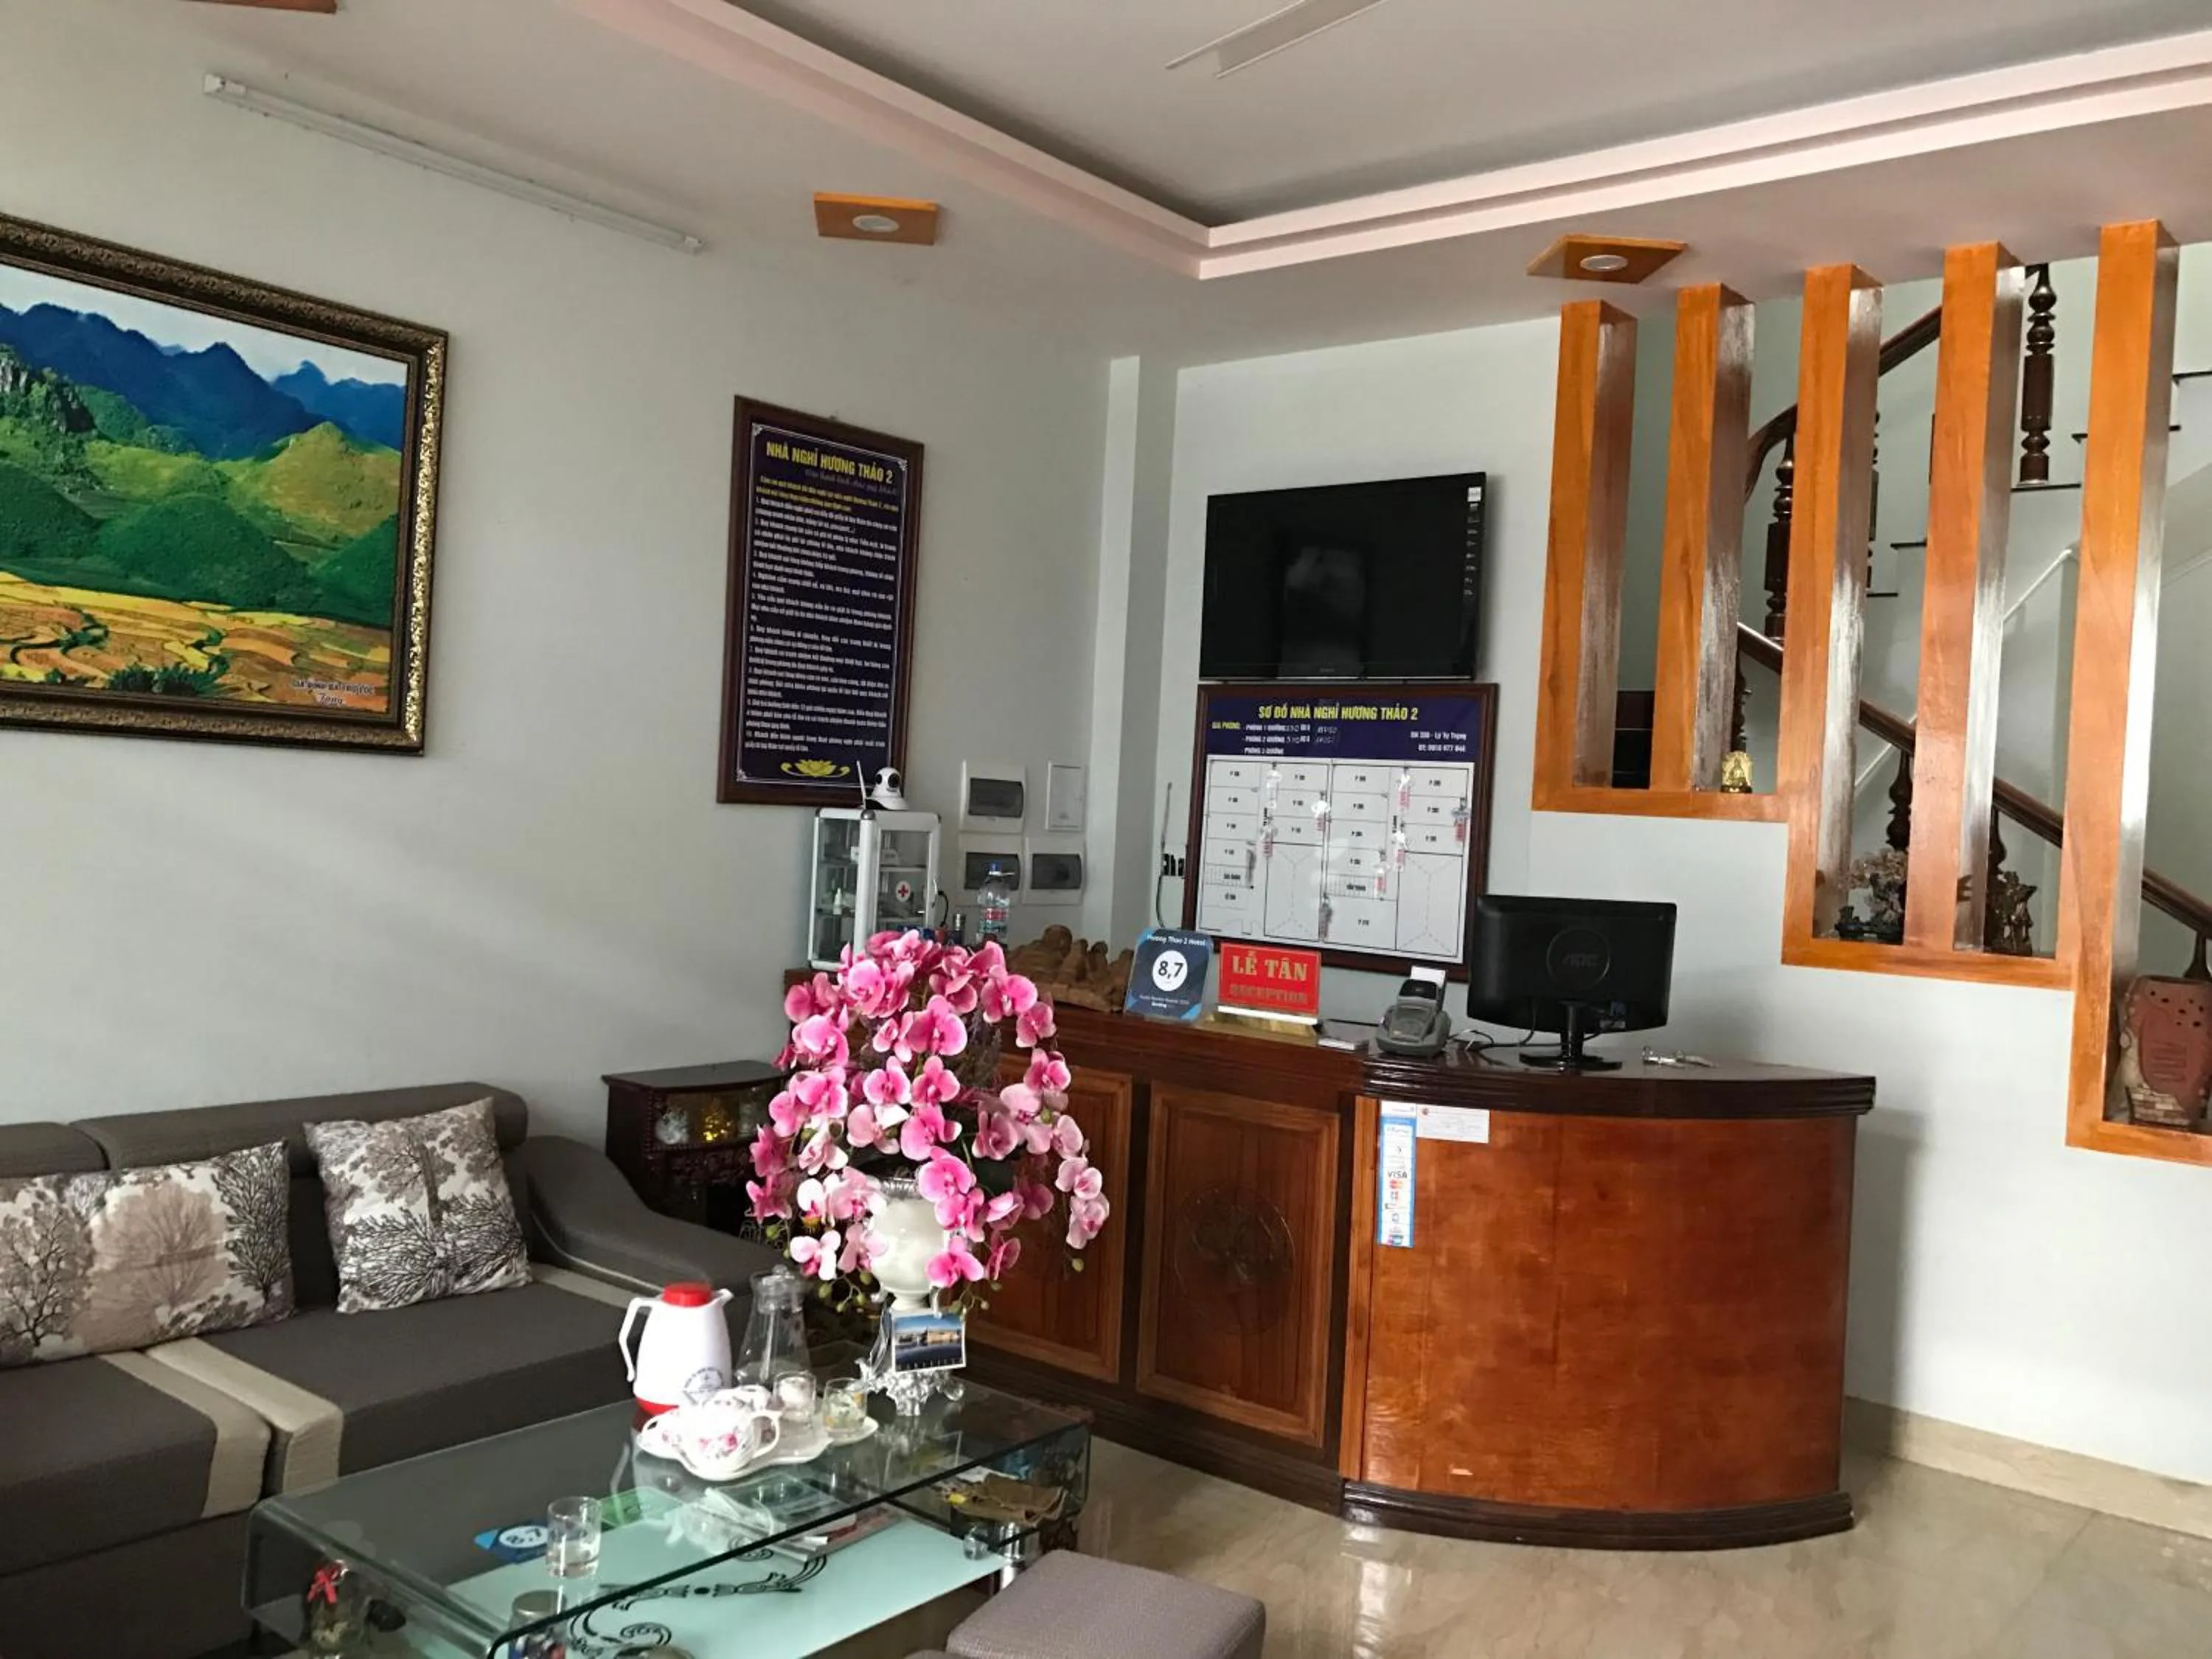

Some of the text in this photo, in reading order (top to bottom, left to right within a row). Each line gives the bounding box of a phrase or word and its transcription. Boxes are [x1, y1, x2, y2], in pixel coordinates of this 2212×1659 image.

[886, 470, 893, 484] 2
[1411, 707, 1418, 720] 2
[1158, 961, 1184, 979] 8,7
[1232, 951, 1308, 982] LỄ TÂN
[1388, 1170, 1408, 1179] VISA
